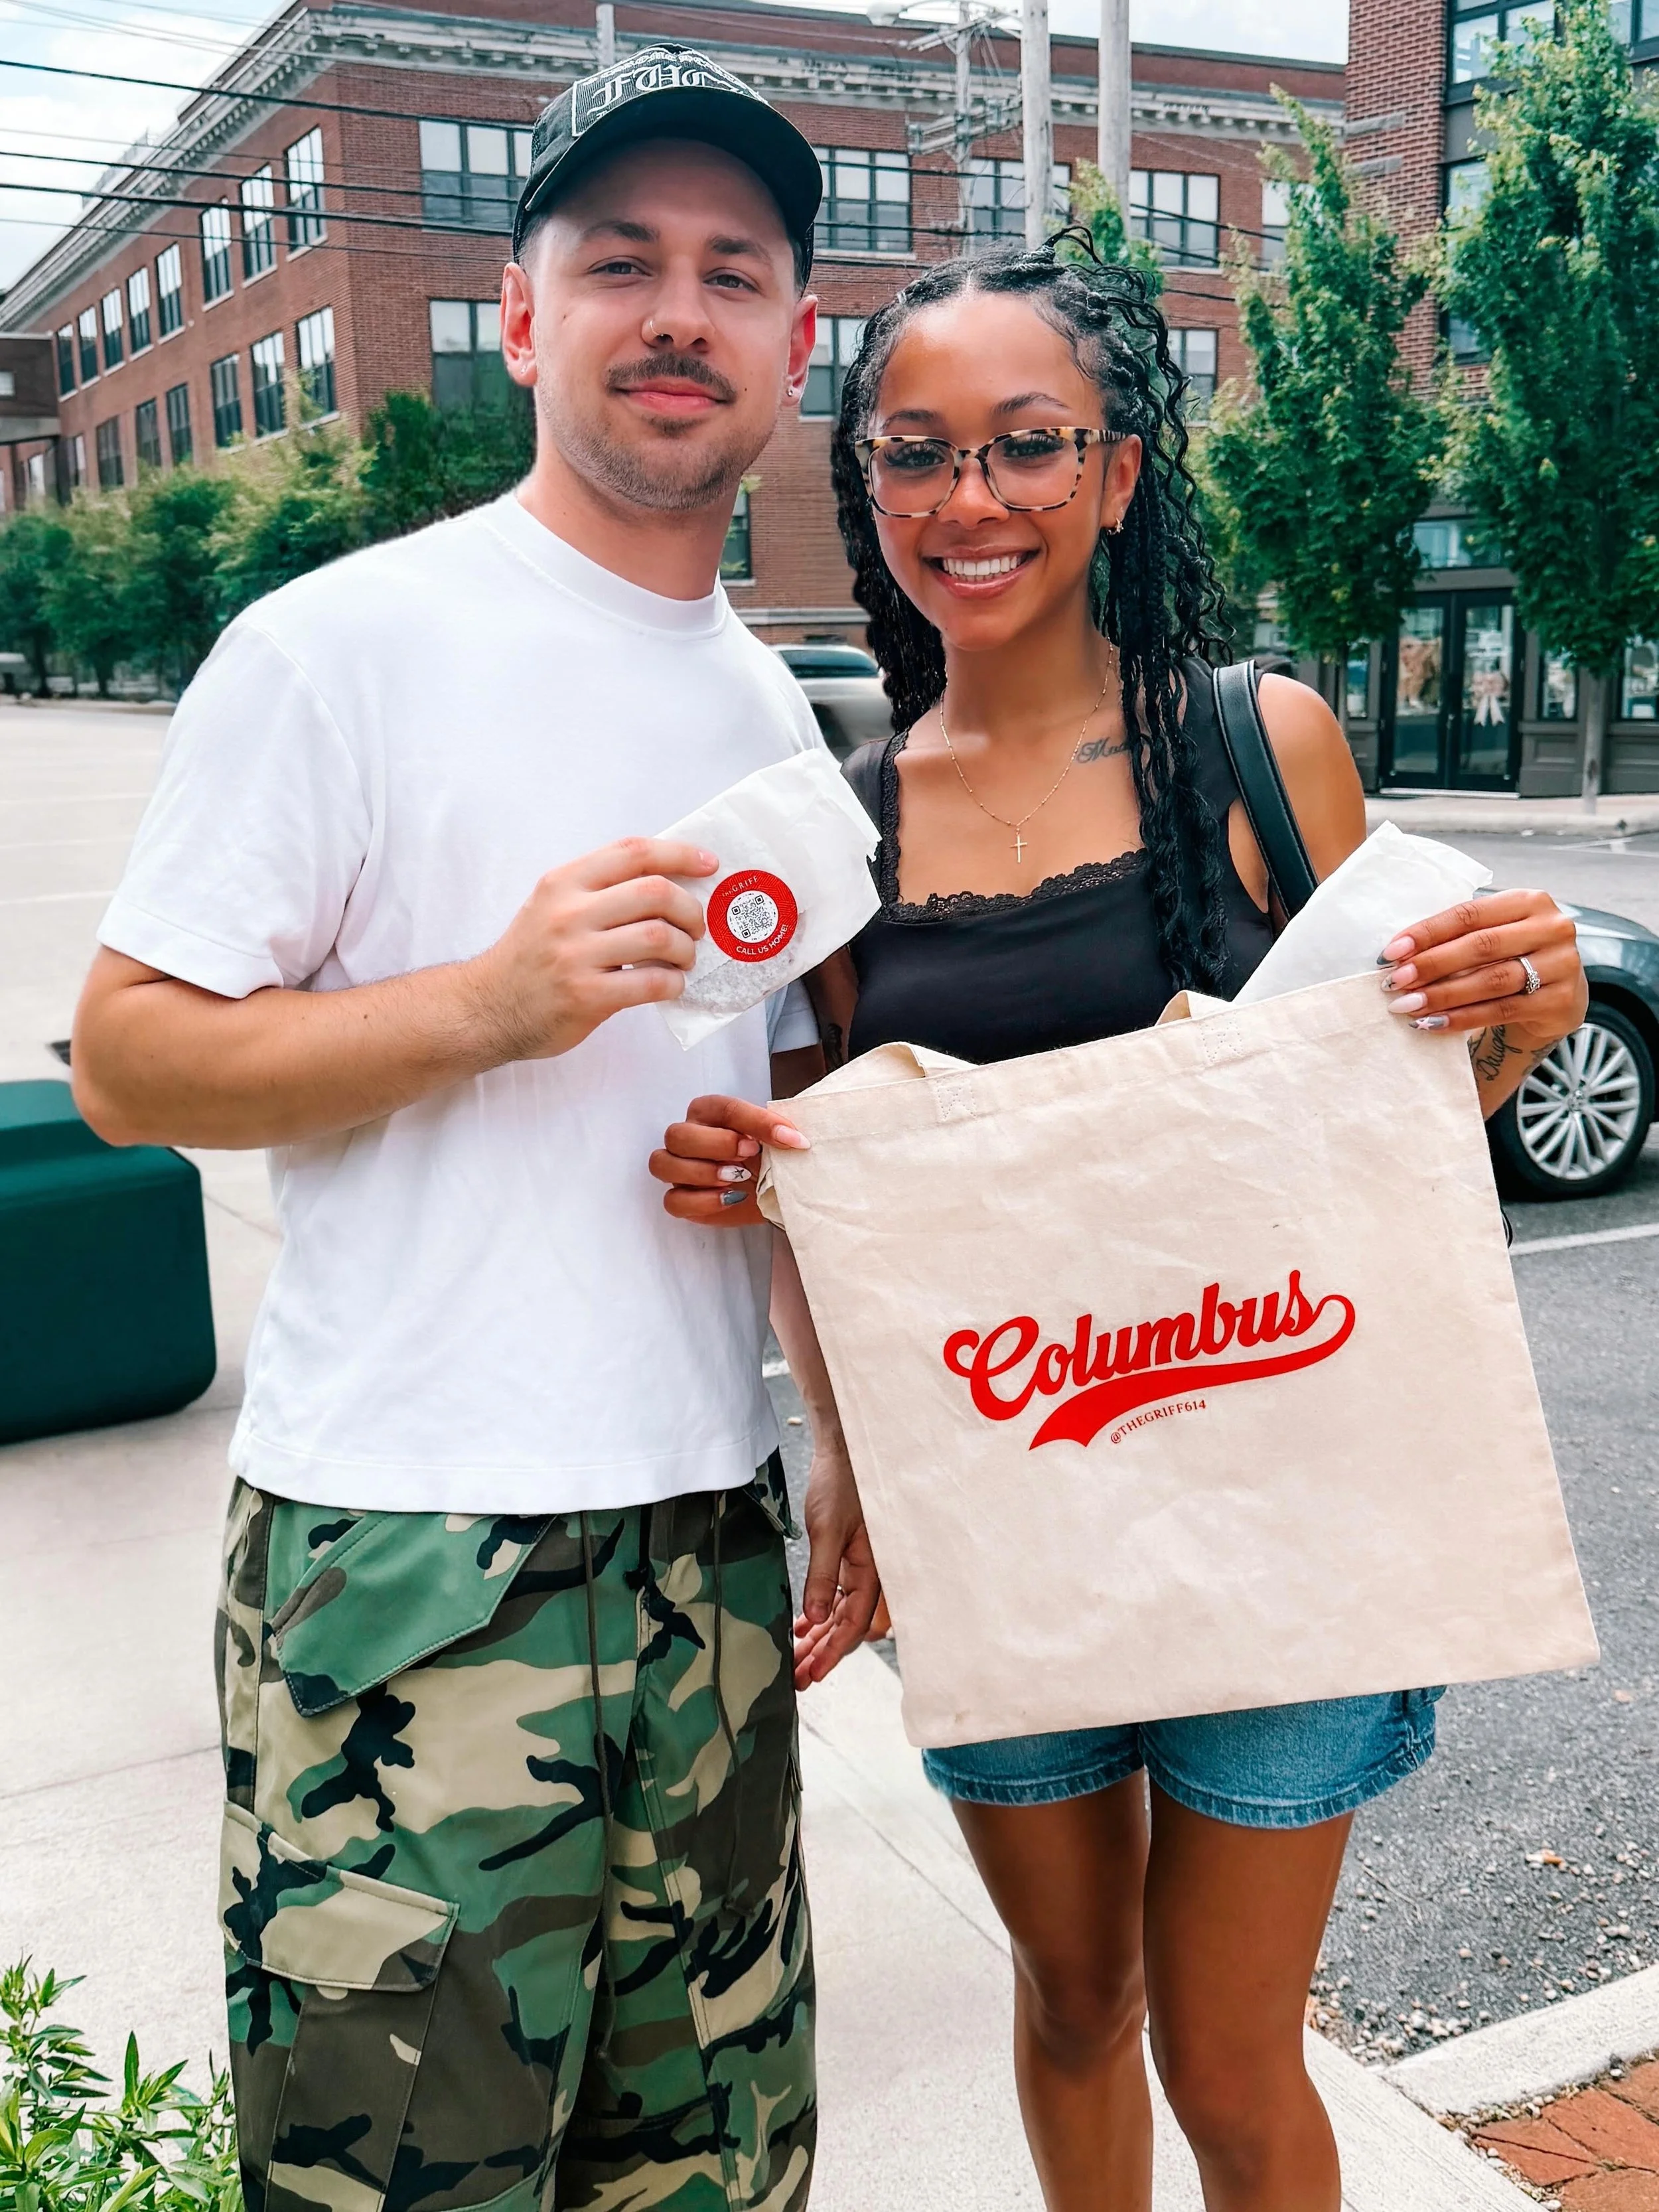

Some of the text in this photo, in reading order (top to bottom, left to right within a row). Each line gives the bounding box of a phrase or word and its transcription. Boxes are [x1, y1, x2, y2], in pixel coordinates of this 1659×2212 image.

[732, 875, 758, 893] GRIFF
[736, 946, 757, 955] CALL
[768, 924, 788, 949] HOME!
[943, 1270, 1355, 1421] Columbus
[1110, 1400, 1207, 1444] @THEGRIFF614
